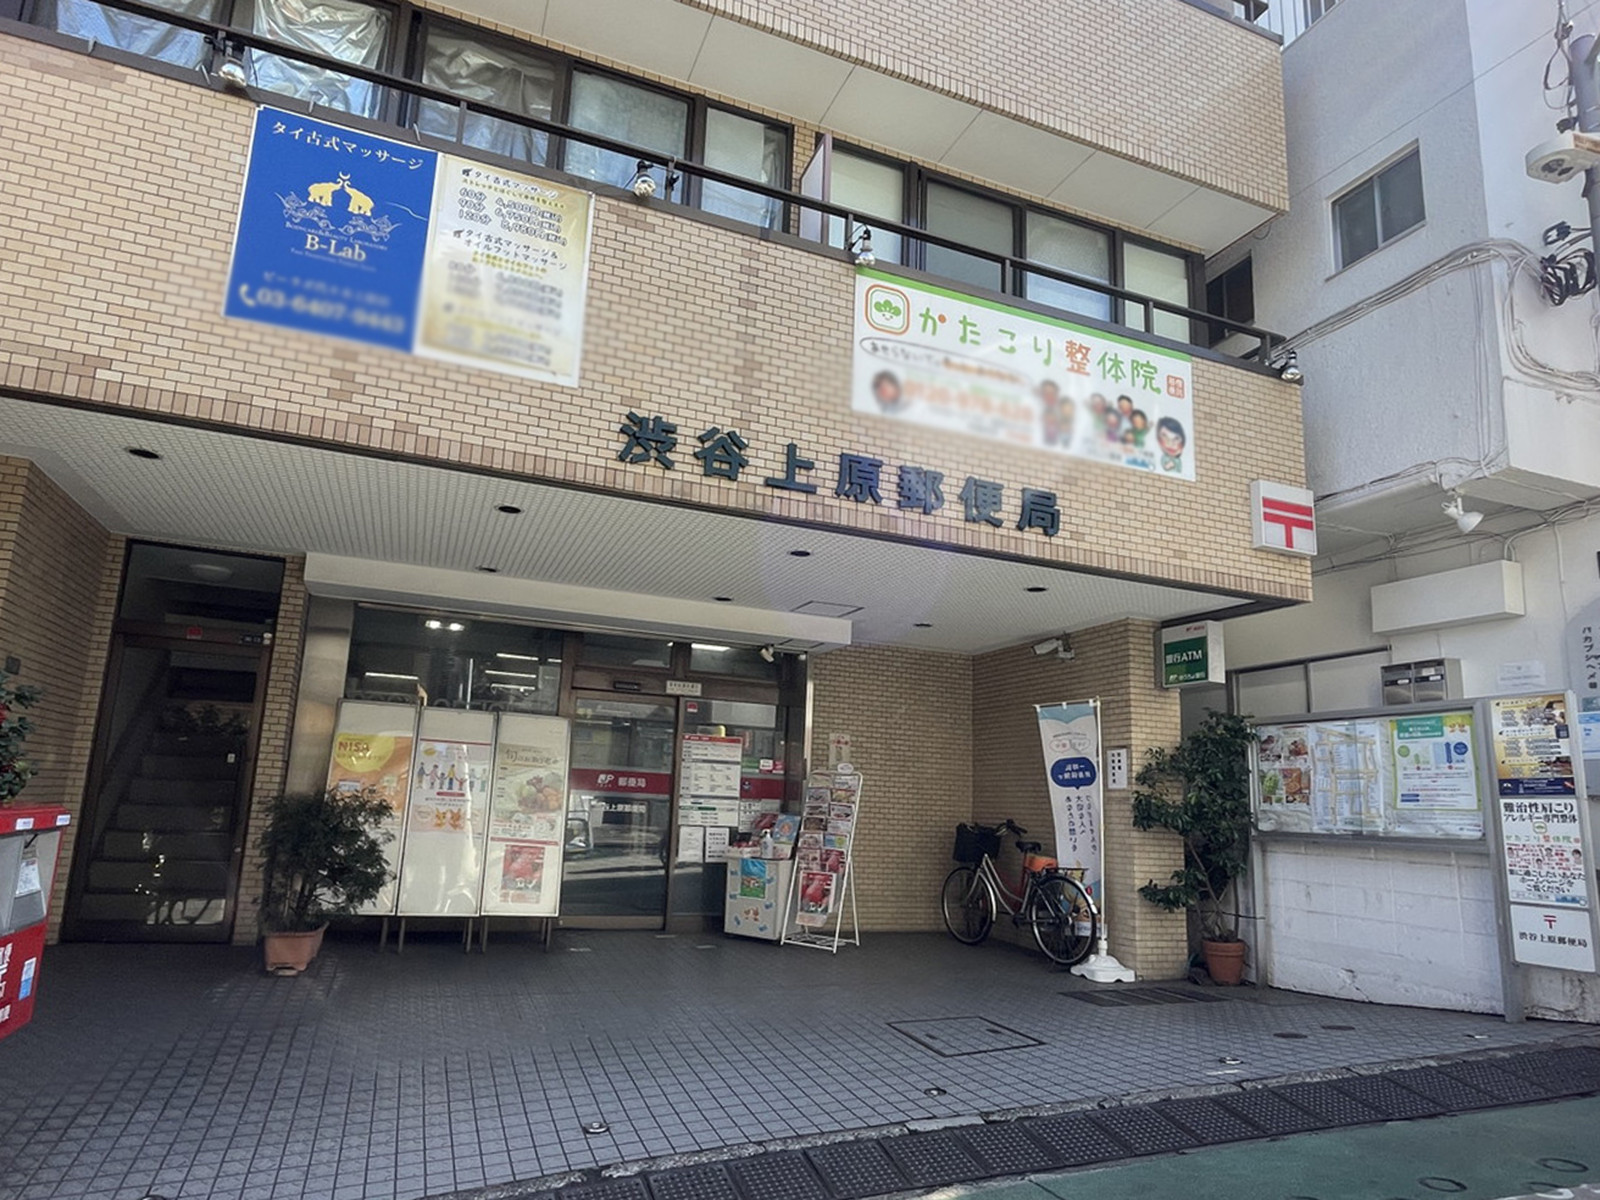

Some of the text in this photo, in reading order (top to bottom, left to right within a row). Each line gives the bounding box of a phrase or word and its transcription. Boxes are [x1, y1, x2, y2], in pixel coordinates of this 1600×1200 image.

[272, 121, 424, 170] タイ古式マッサージ
[474, 171, 558, 198] タイ古式マッサージ
[304, 233, 366, 261] B-Lab
[918, 306, 1162, 394] かたこり整体院
[618, 410, 1061, 538] 渋谷上原郵便局
[1503, 802, 1574, 814] 難治性肩こり
[1503, 813, 1578, 824] アレルギー専門整体
[1519, 931, 1588, 948] 渋谷上原郵便局
